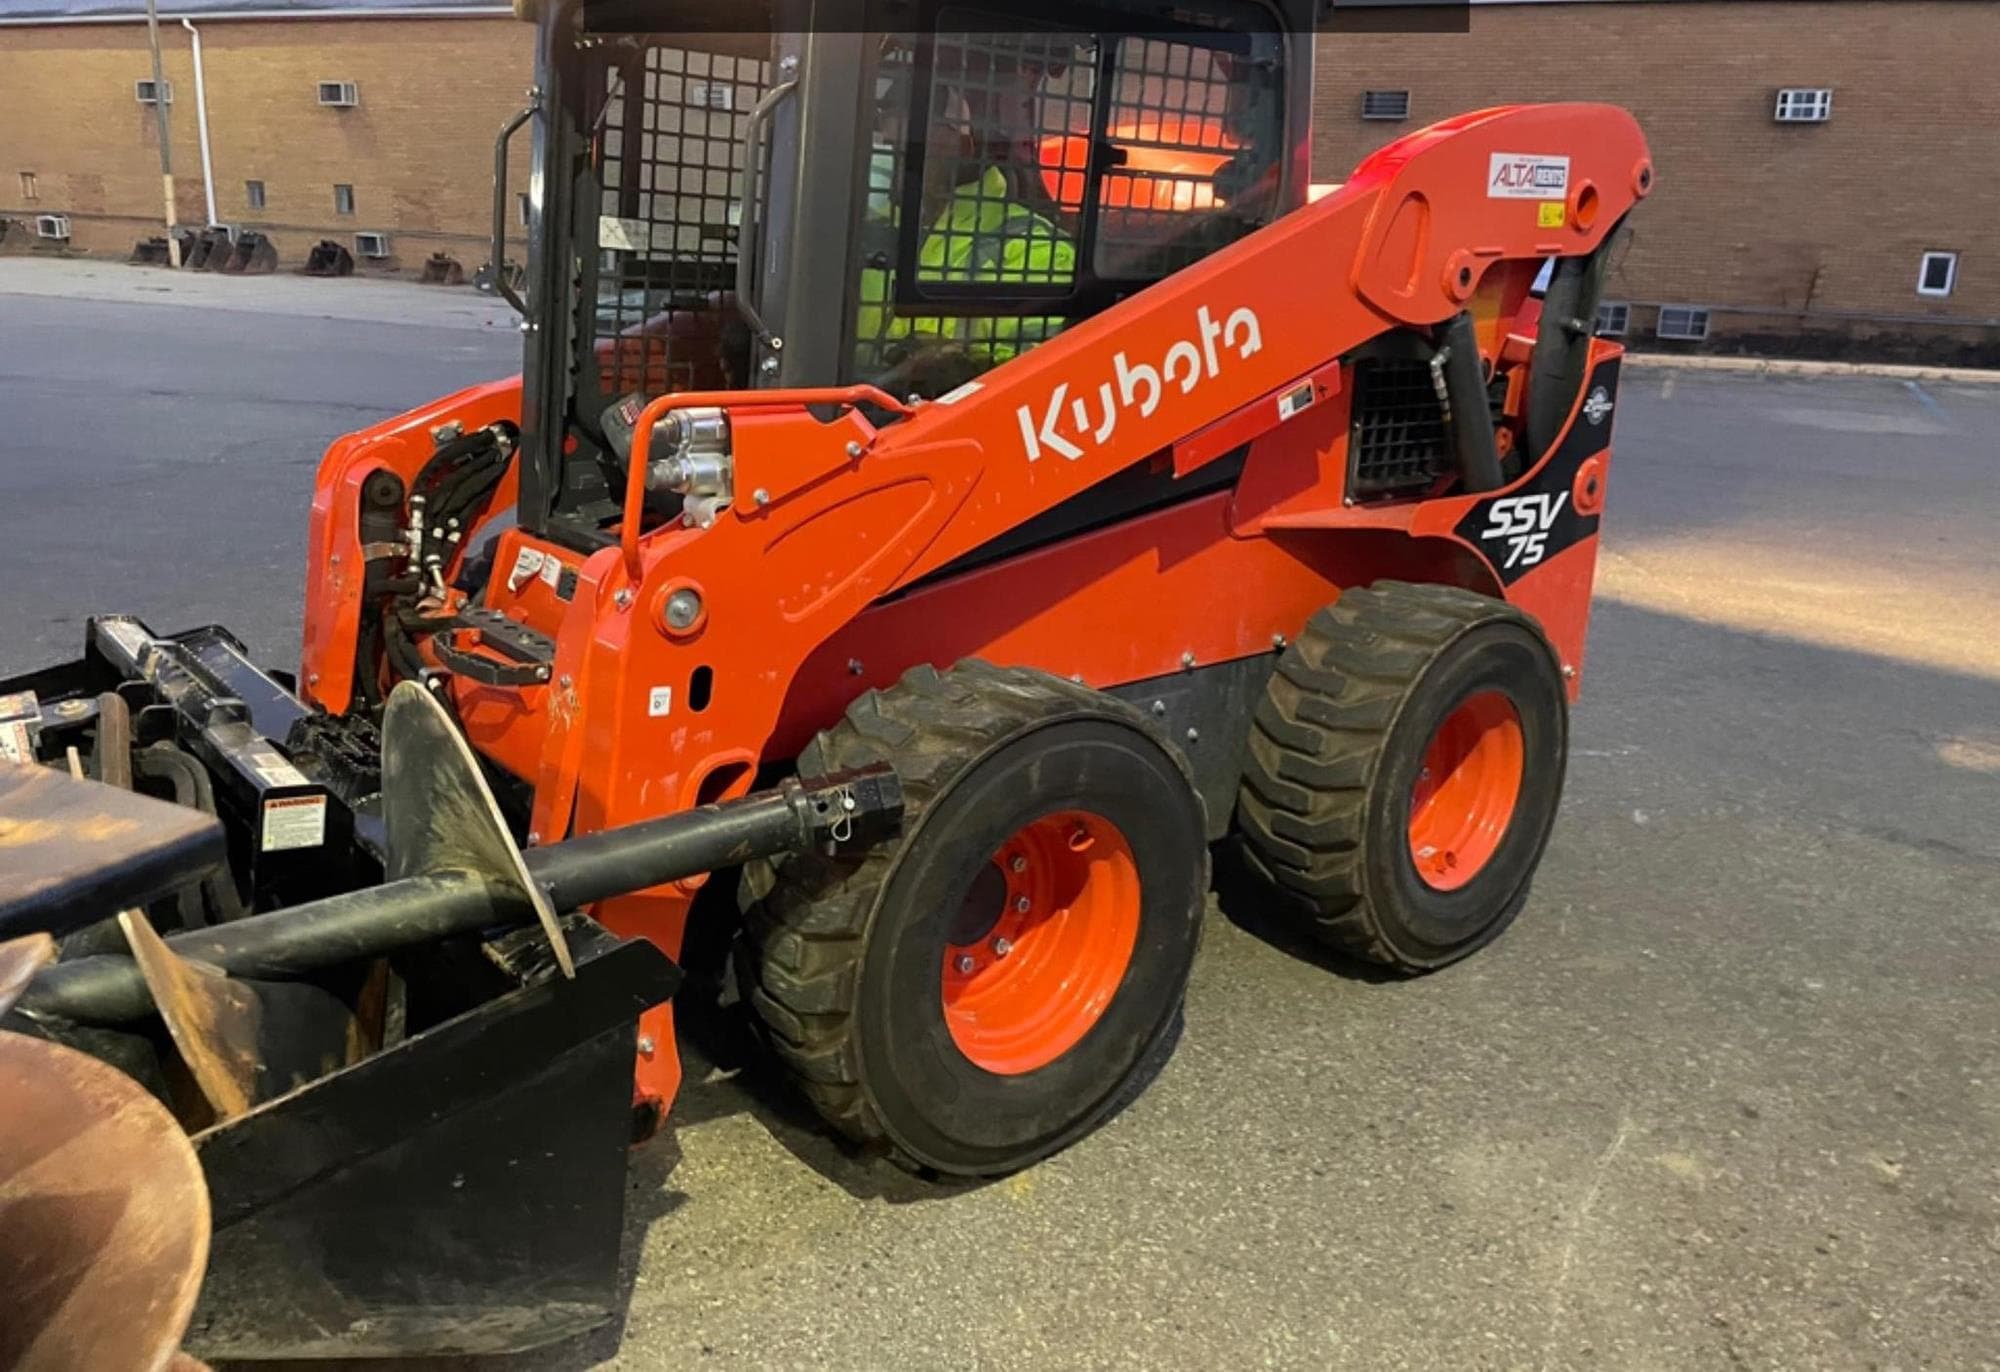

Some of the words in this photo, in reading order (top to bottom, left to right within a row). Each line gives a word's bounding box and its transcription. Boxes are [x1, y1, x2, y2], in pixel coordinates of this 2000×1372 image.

[1493, 163, 1535, 188] ALTA
[1017, 305, 1262, 463] Kubota
[1481, 491, 1570, 539] SSV
[1503, 532, 1549, 568] 75
